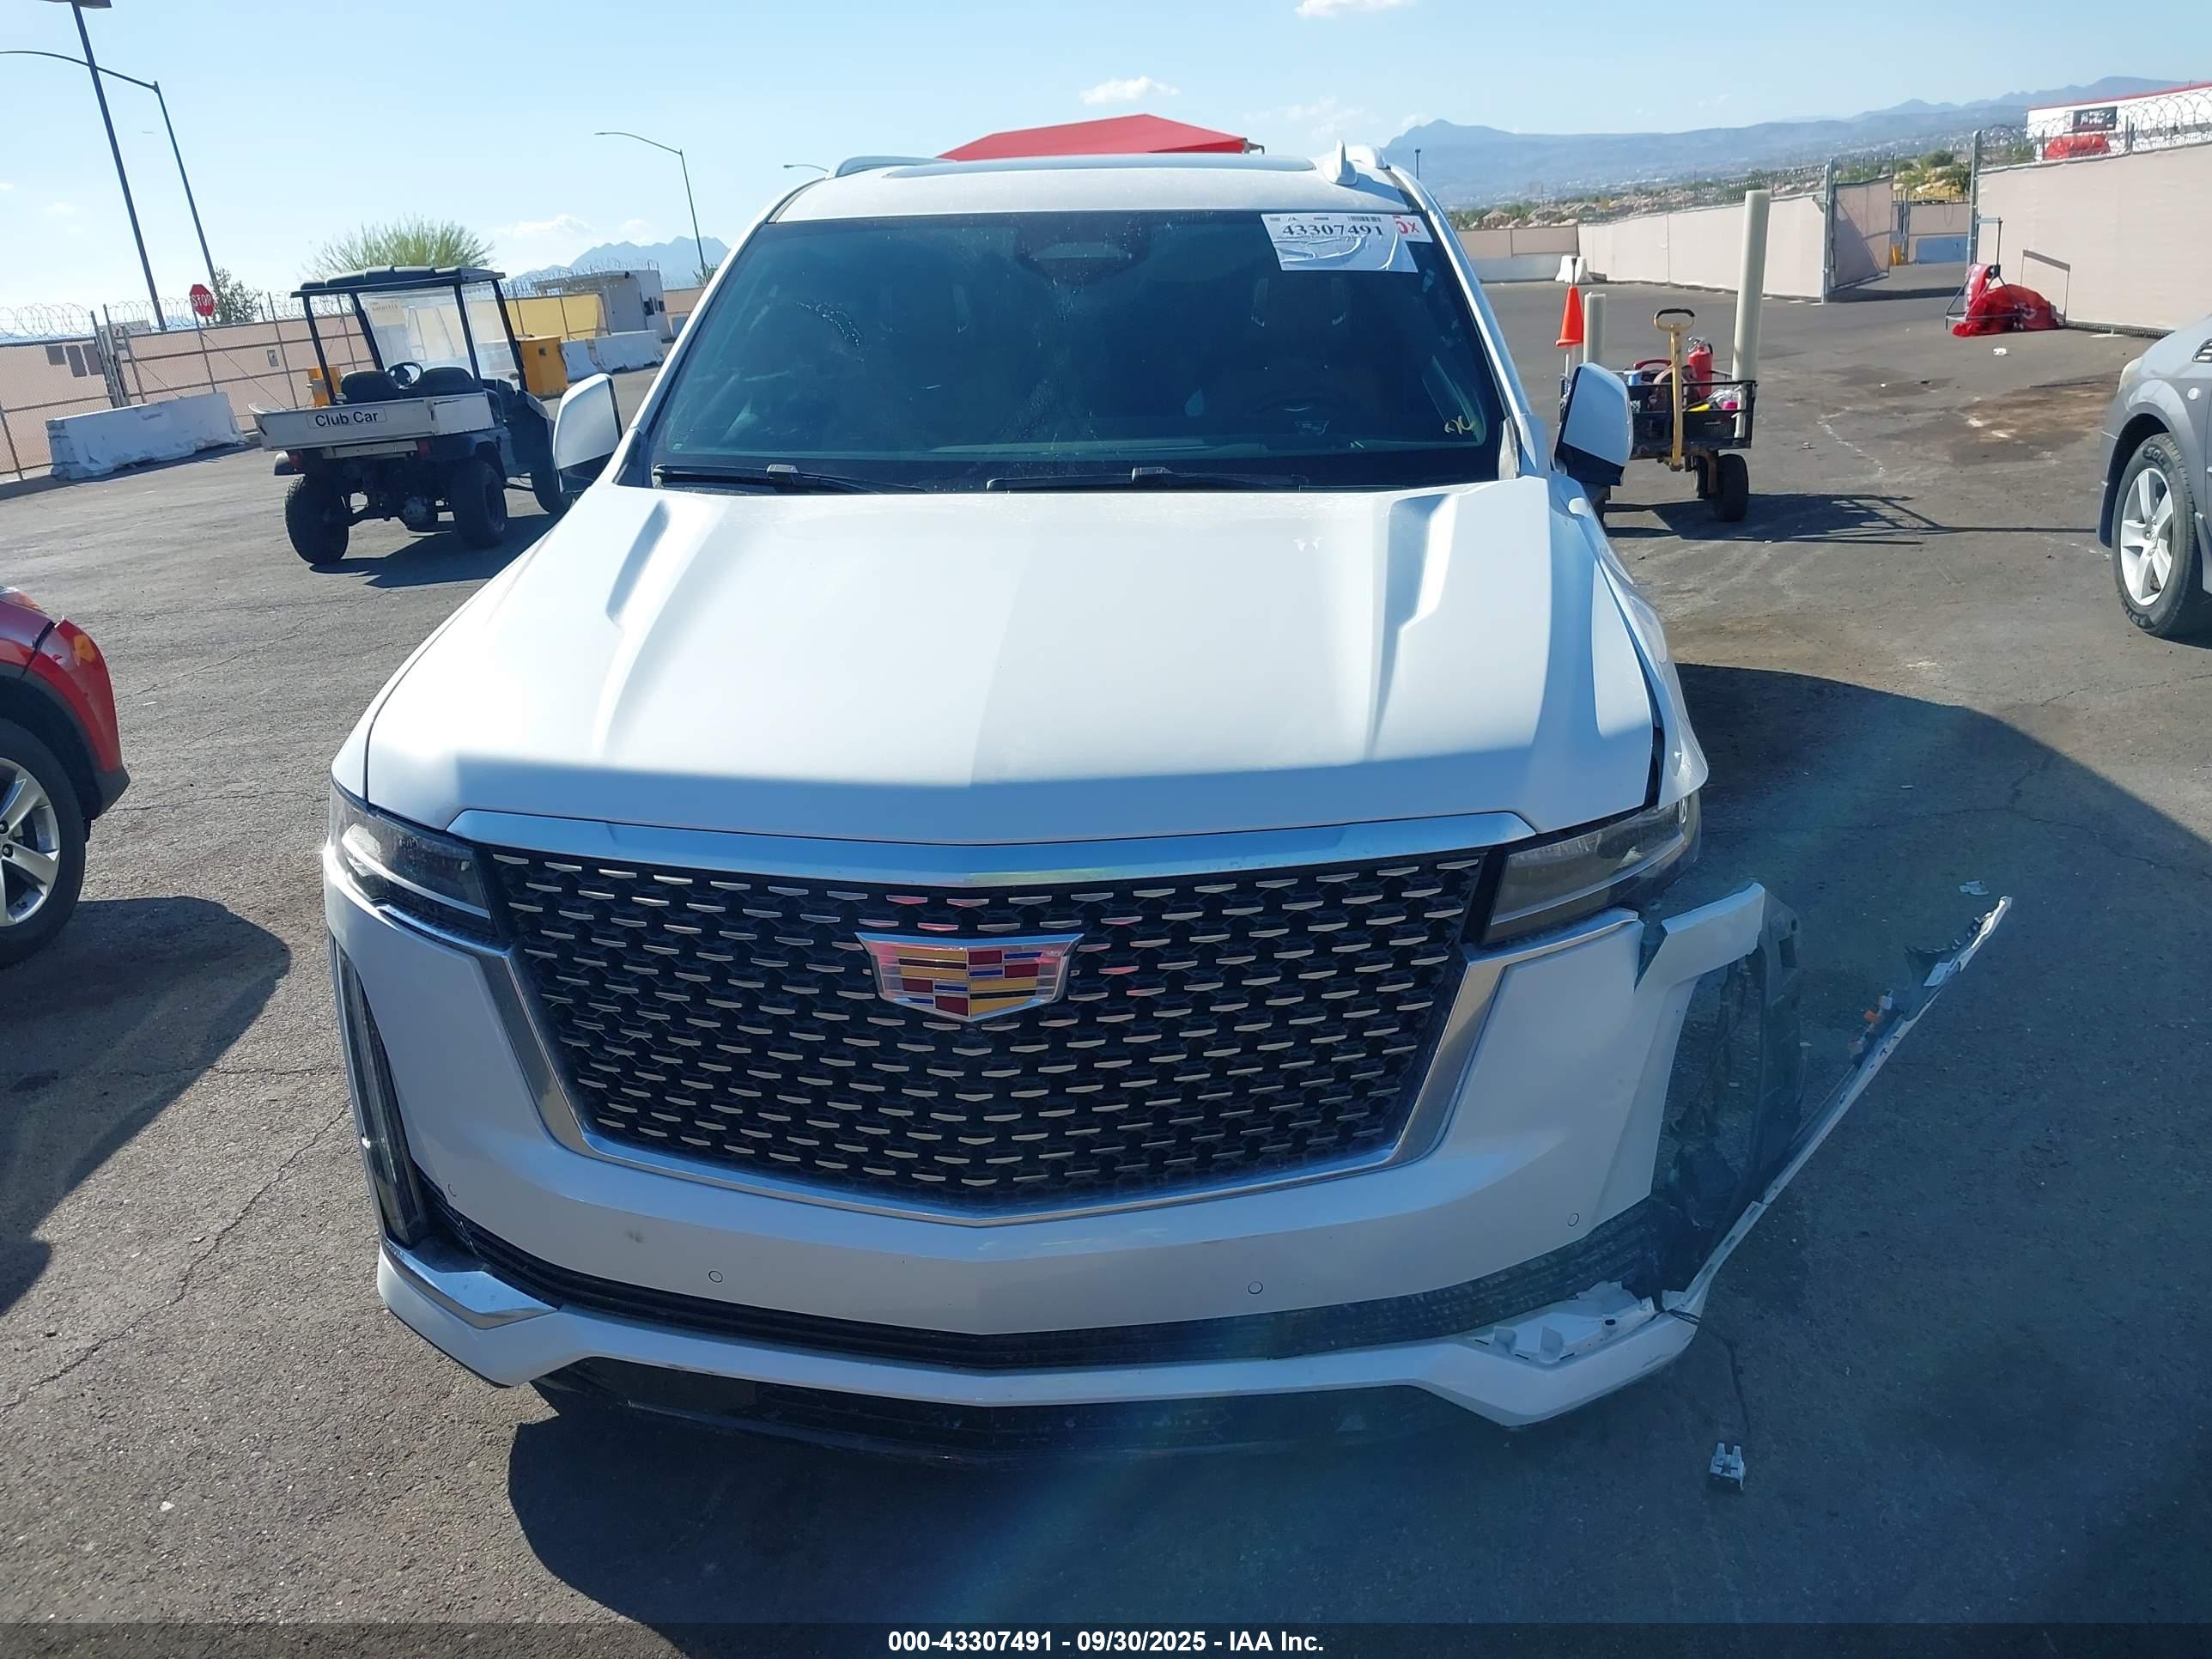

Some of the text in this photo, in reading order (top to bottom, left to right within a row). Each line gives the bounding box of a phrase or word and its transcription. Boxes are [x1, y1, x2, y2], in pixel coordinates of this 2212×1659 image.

[1282, 224, 1383, 236] 43307491
[191, 294, 212, 307] STOP
[315, 411, 378, 427] Club Car
